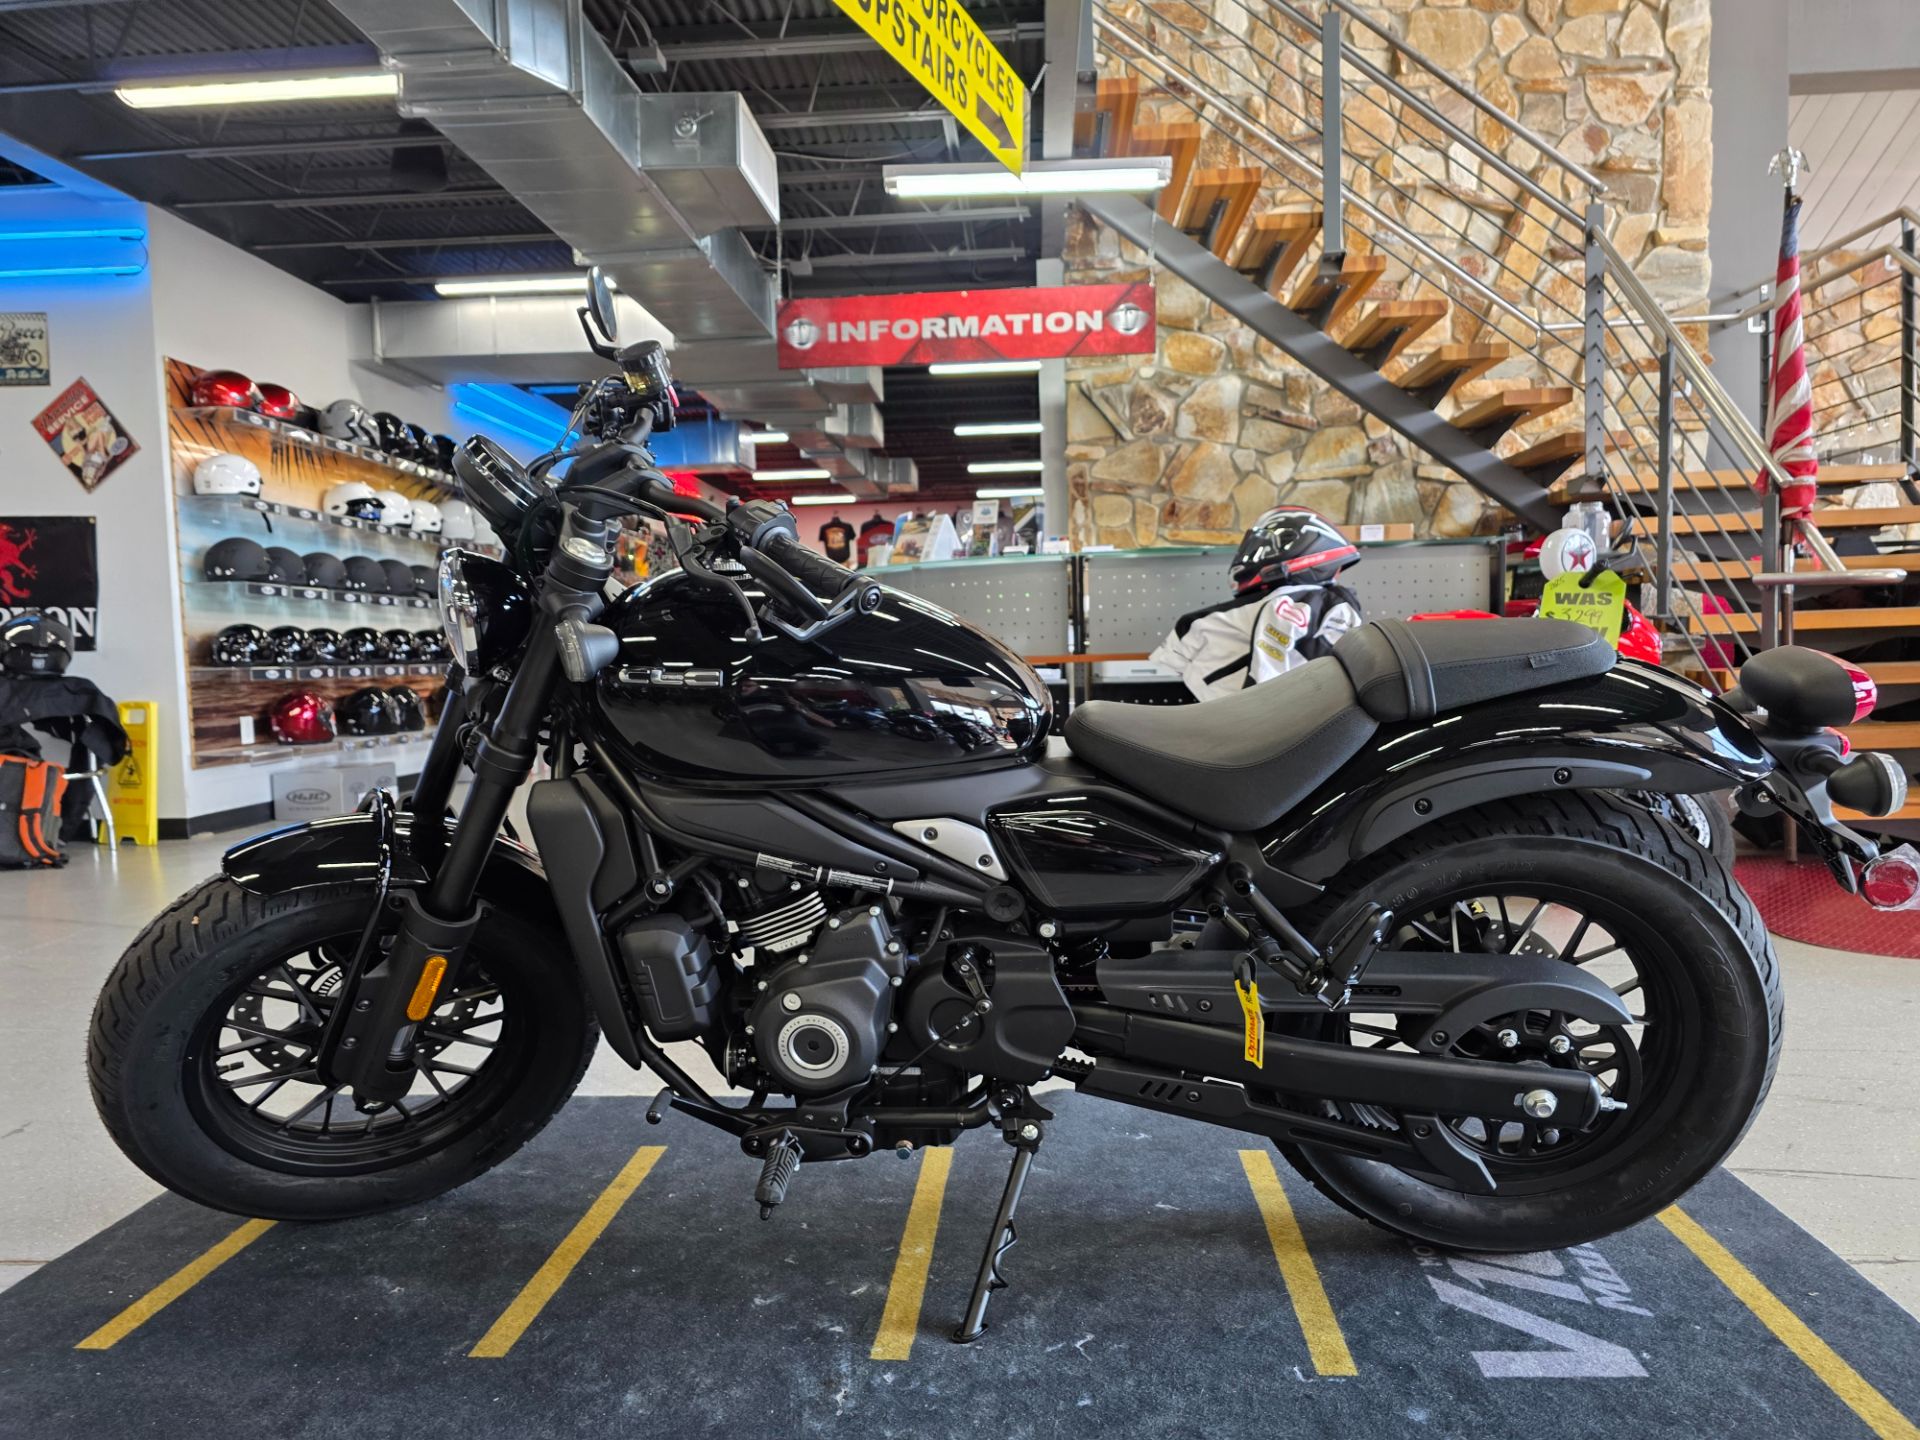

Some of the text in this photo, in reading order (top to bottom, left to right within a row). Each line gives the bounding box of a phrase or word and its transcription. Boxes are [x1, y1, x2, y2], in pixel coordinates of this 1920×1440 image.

[912, 0, 1014, 112] ORCYCLES
[827, 309, 1103, 343] INFORMATION
[1555, 592, 1613, 605] WAS
